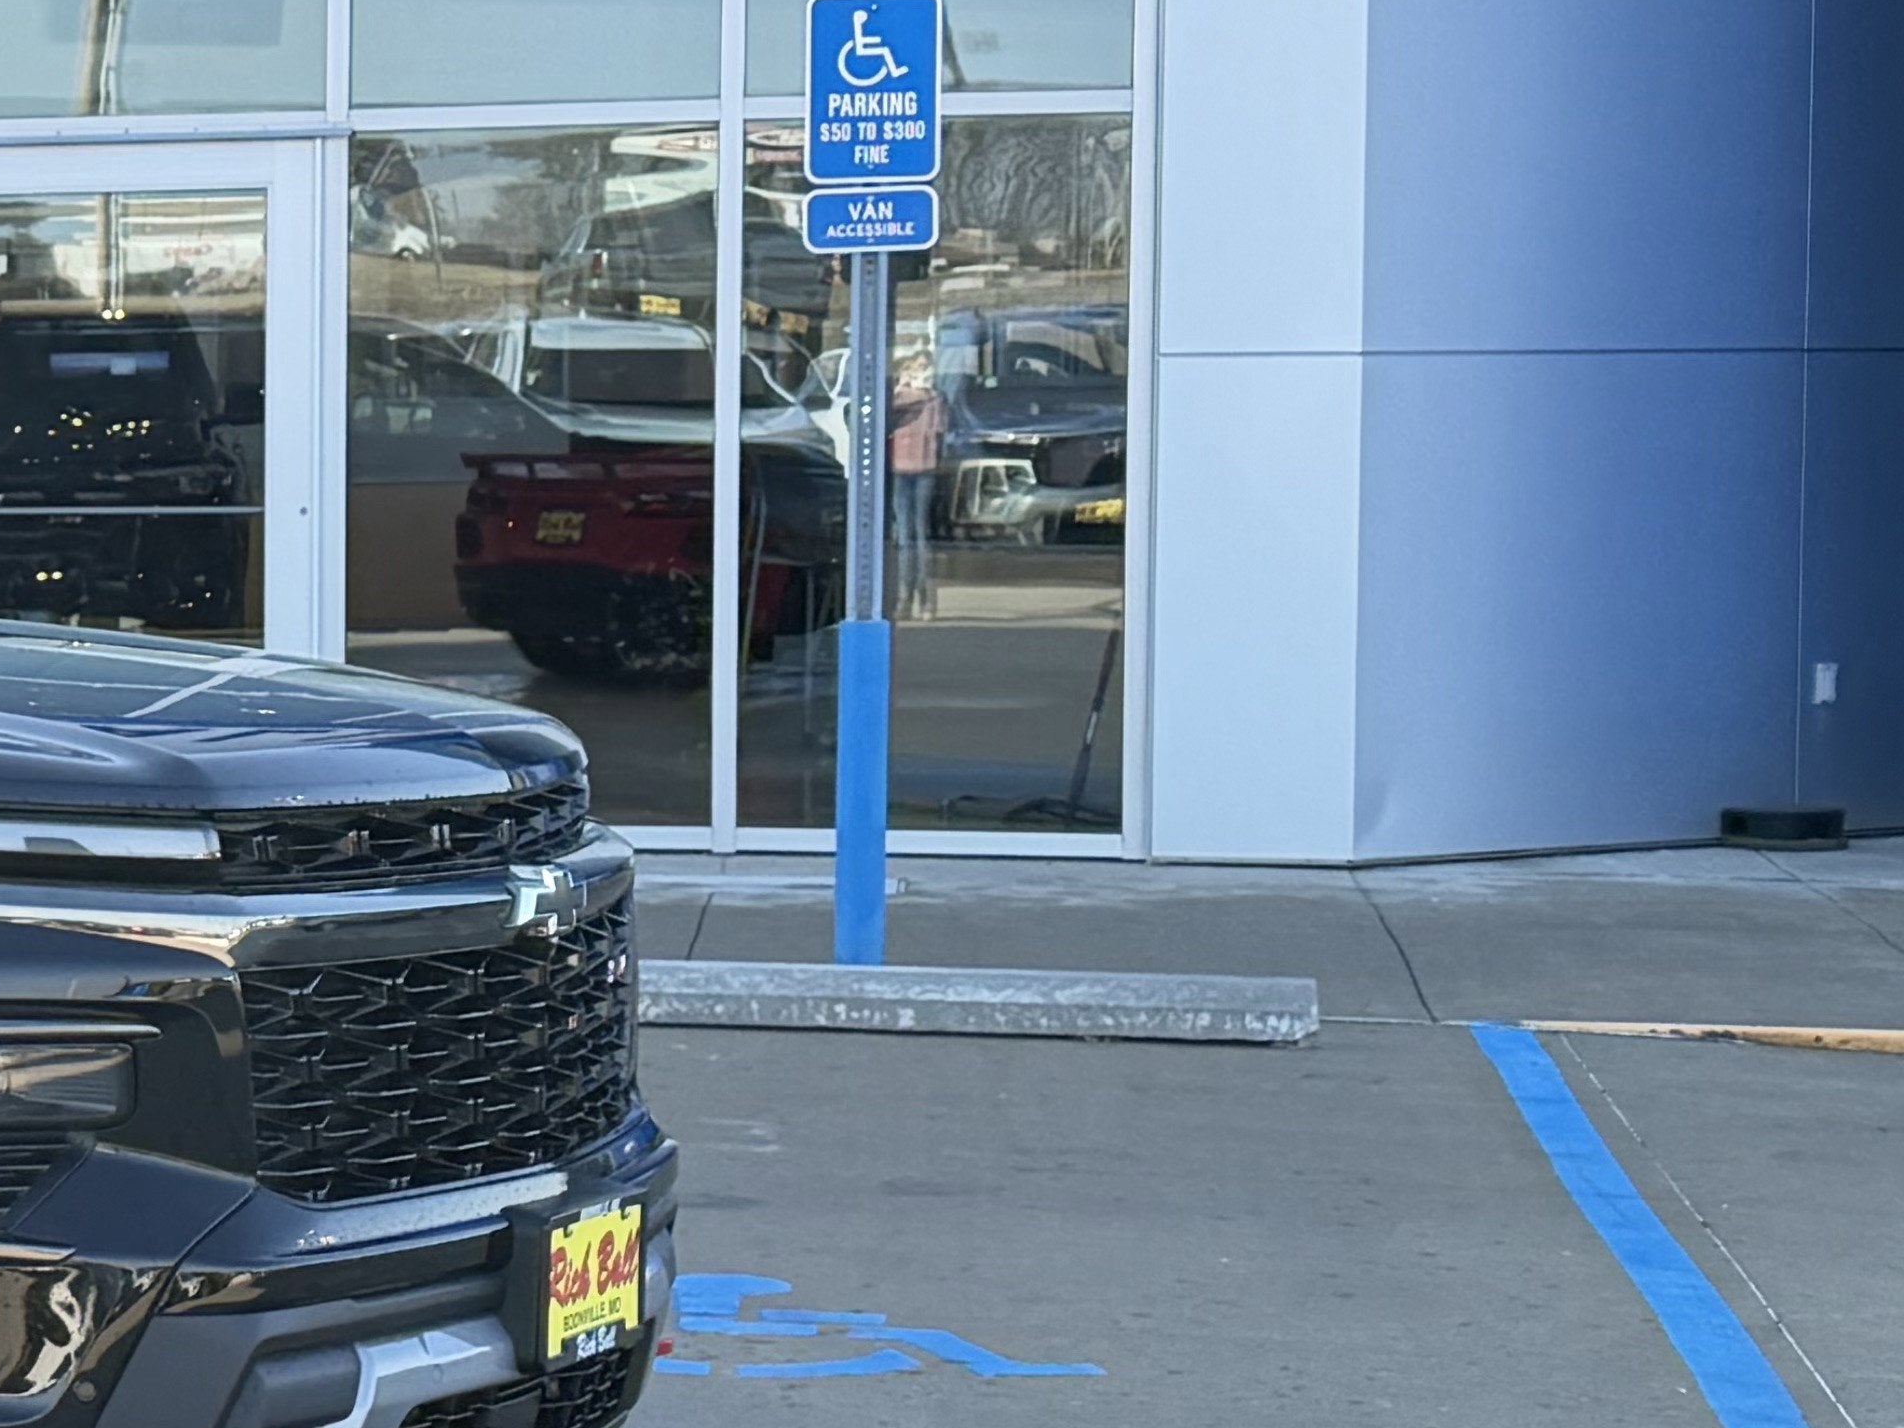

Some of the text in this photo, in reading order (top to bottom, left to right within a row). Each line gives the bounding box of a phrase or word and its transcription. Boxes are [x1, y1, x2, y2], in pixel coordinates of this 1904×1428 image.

[828, 91, 918, 117] PARKING
[820, 120, 926, 142] $50 TO $300
[853, 144, 890, 164] FINE
[848, 201, 894, 221] VAN
[826, 221, 915, 238] ACCESSIBLE
[550, 1228, 640, 1308] Rick Ball
